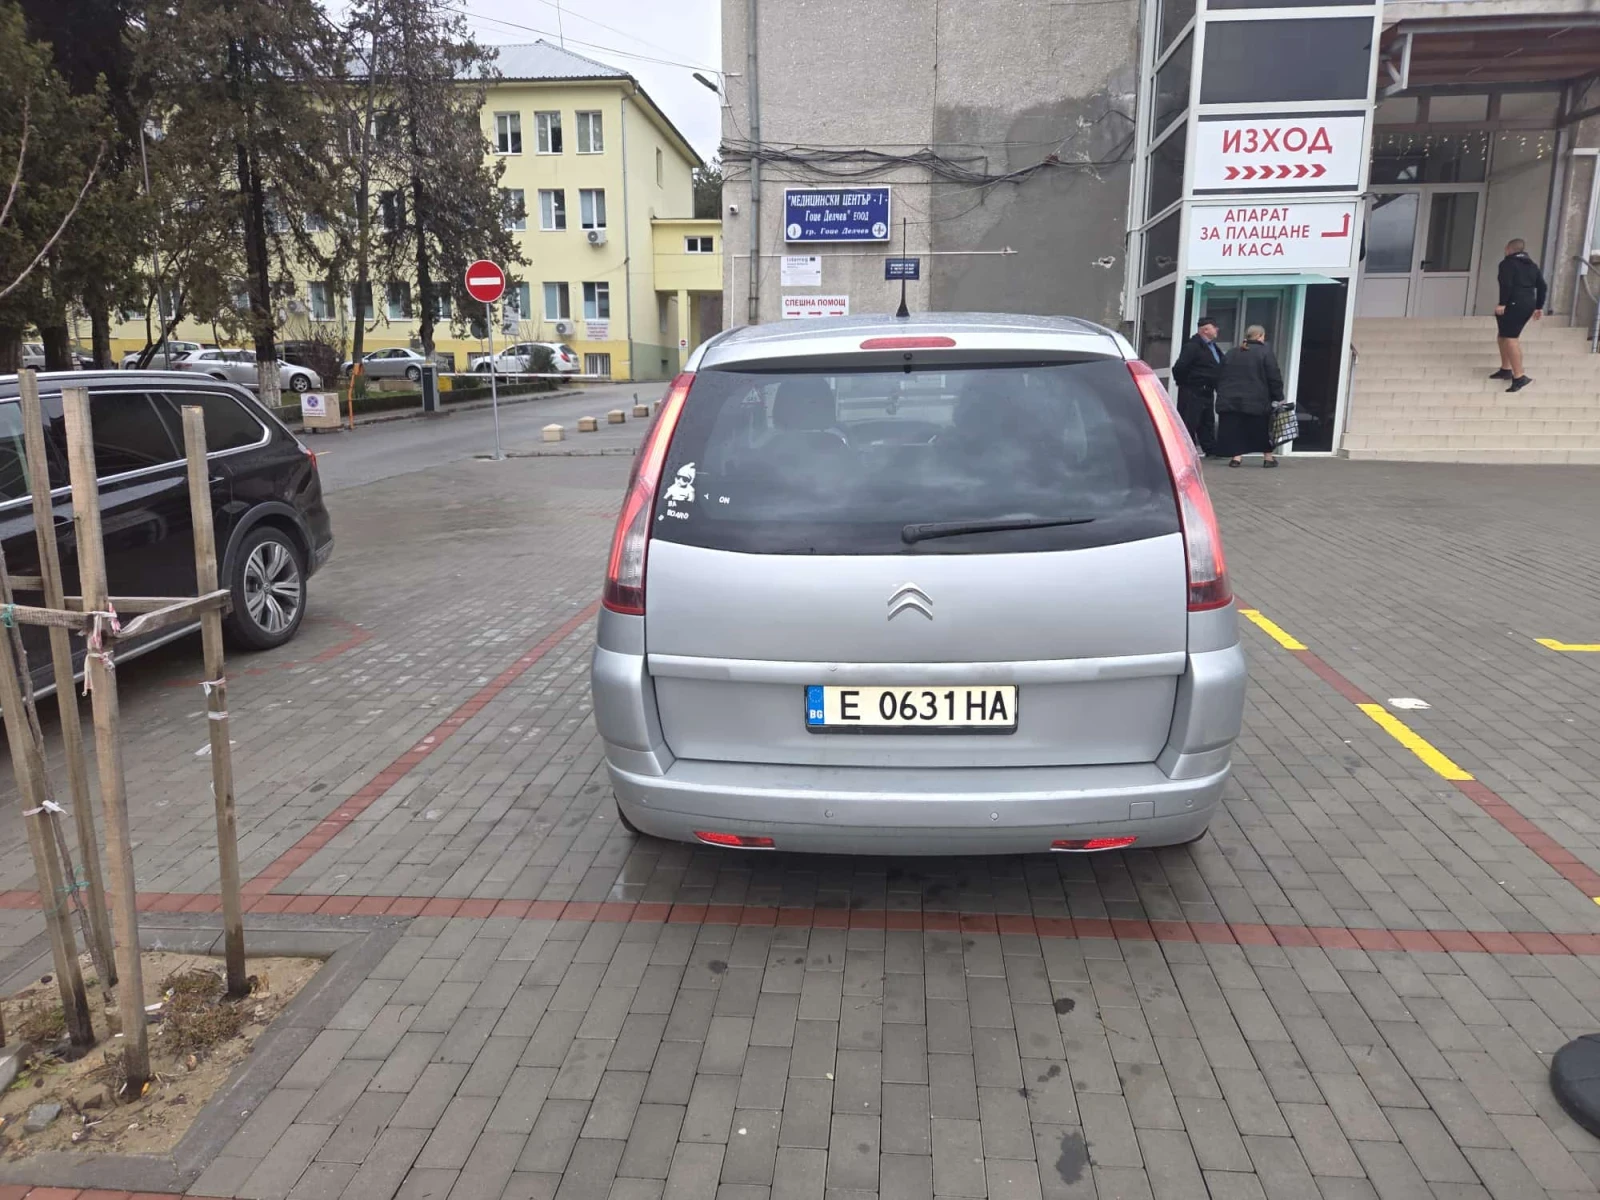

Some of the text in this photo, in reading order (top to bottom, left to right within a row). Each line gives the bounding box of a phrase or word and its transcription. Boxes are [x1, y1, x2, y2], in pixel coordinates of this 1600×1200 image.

[1222, 127, 1333, 154] ИЗХОД
[842, 194, 871, 206] ЦЕНТЪР
[853, 211, 869, 221] ЕООД
[1224, 208, 1289, 223] АПАРАТ
[1200, 225, 1310, 241] ЗА ПЛАЩАНЕ
[1222, 243, 1284, 257] И КАСА
[785, 298, 846, 307] СПЕШНА ПОМОЩ
[718, 496, 730, 504] ON
[840, 690, 861, 720] E
[809, 709, 824, 719] BG
